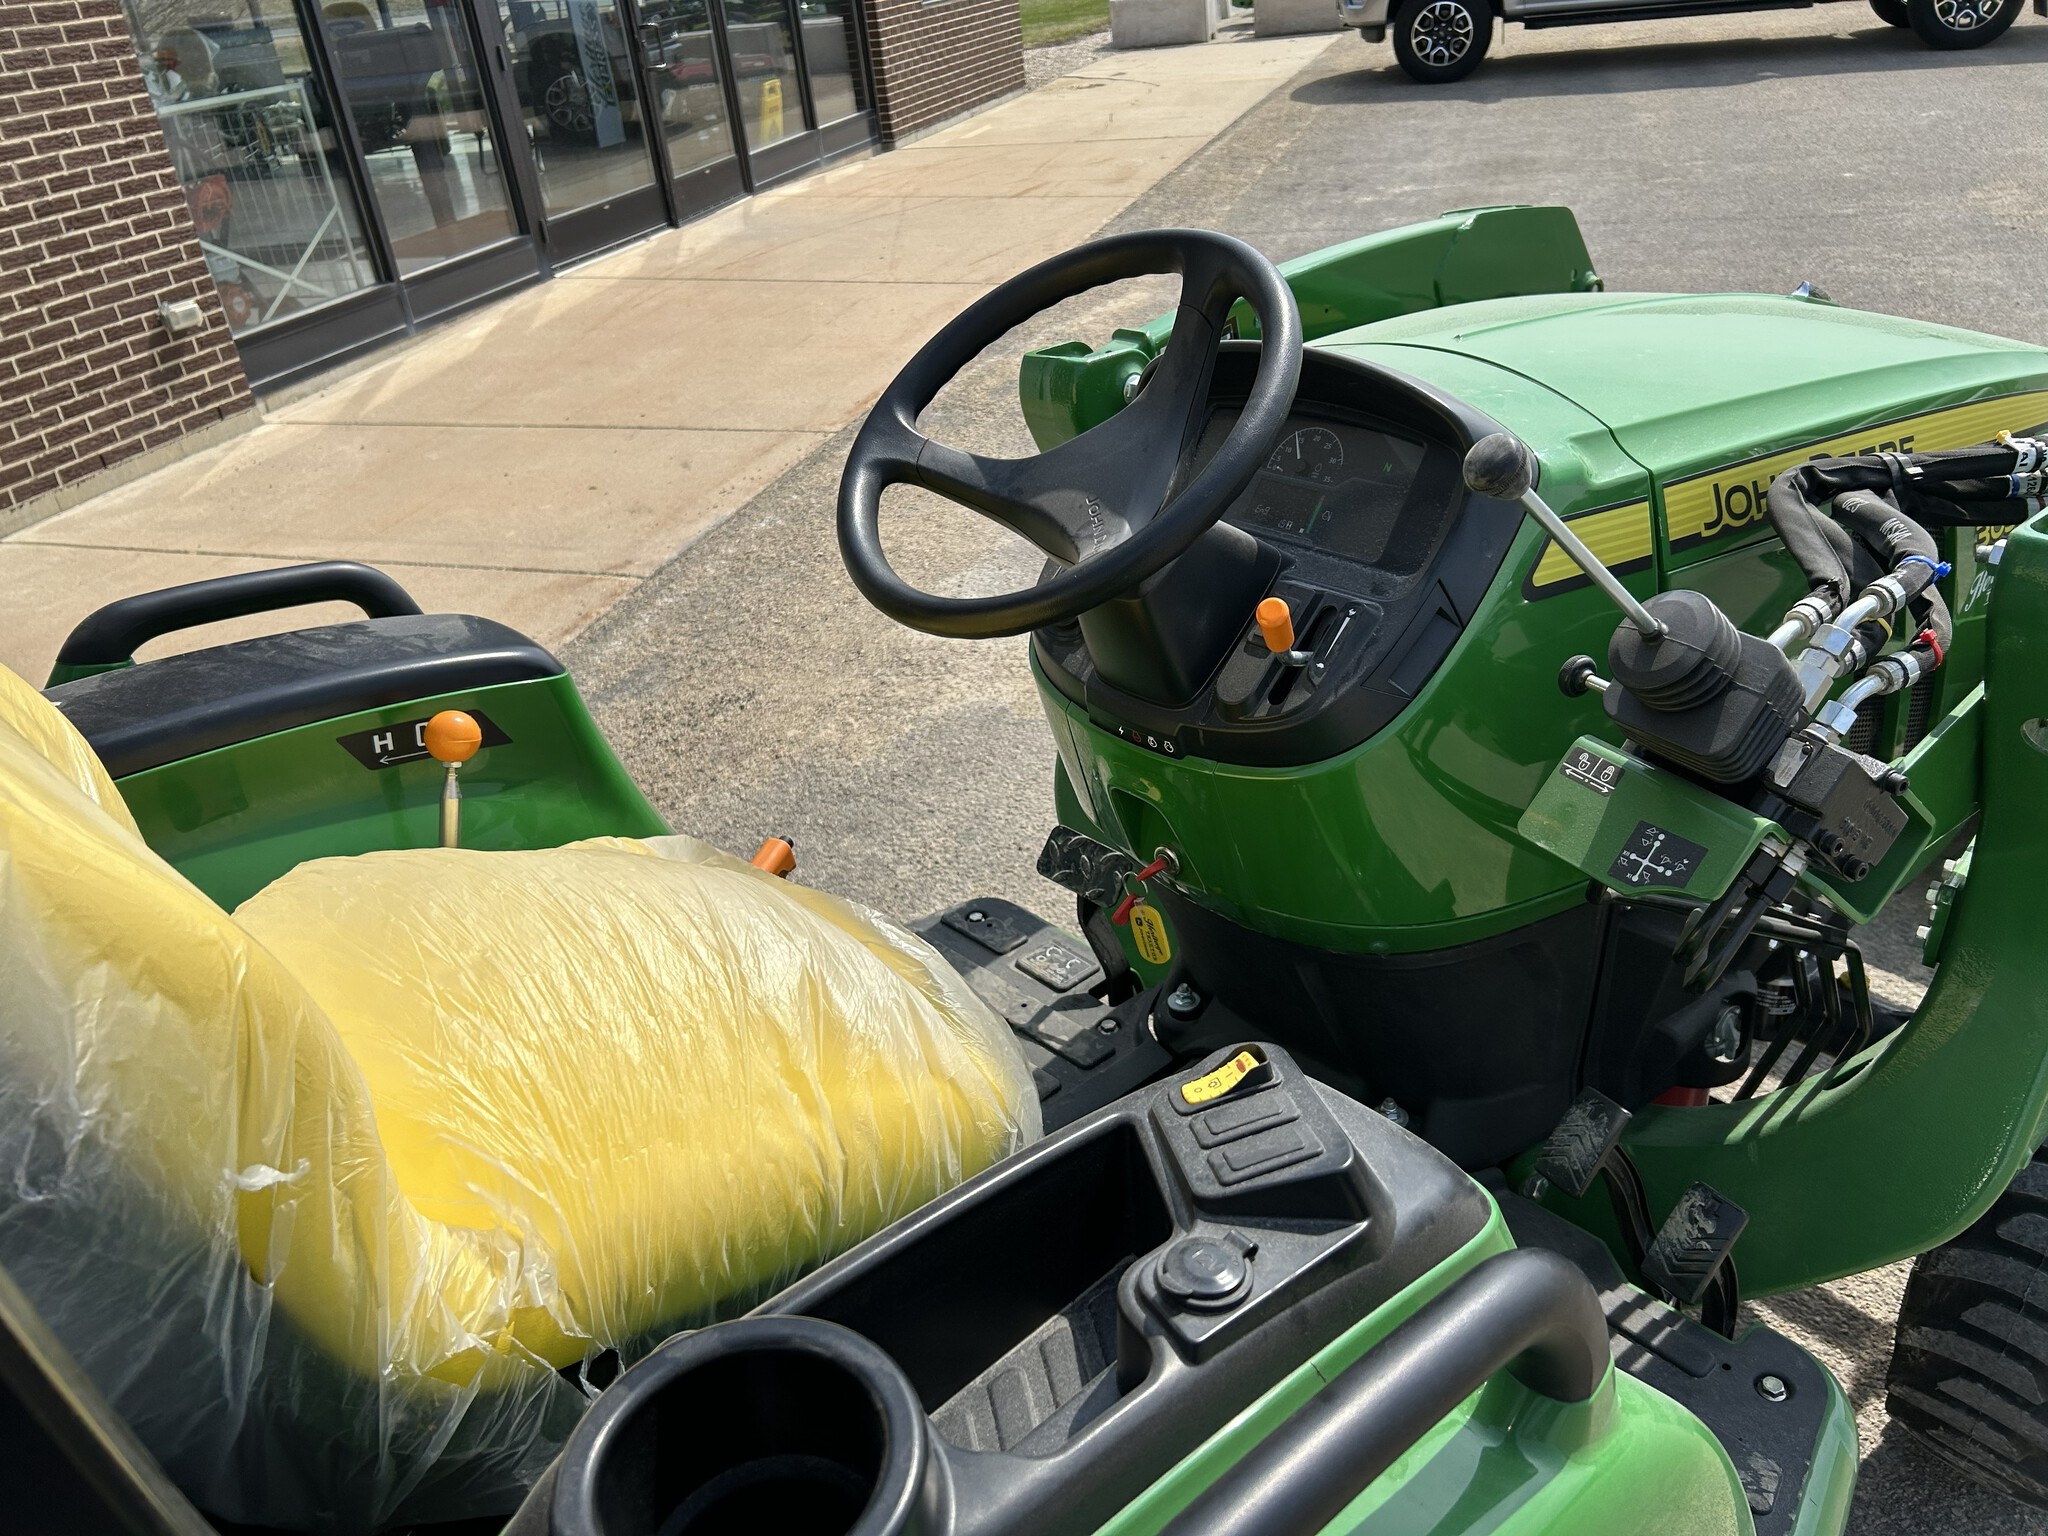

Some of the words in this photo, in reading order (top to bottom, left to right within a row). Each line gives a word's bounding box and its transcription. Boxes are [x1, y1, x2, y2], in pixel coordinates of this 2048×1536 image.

[1383, 463, 1392, 473] N
[1085, 496, 1106, 535] JOHN
[372, 732, 394, 754] H
